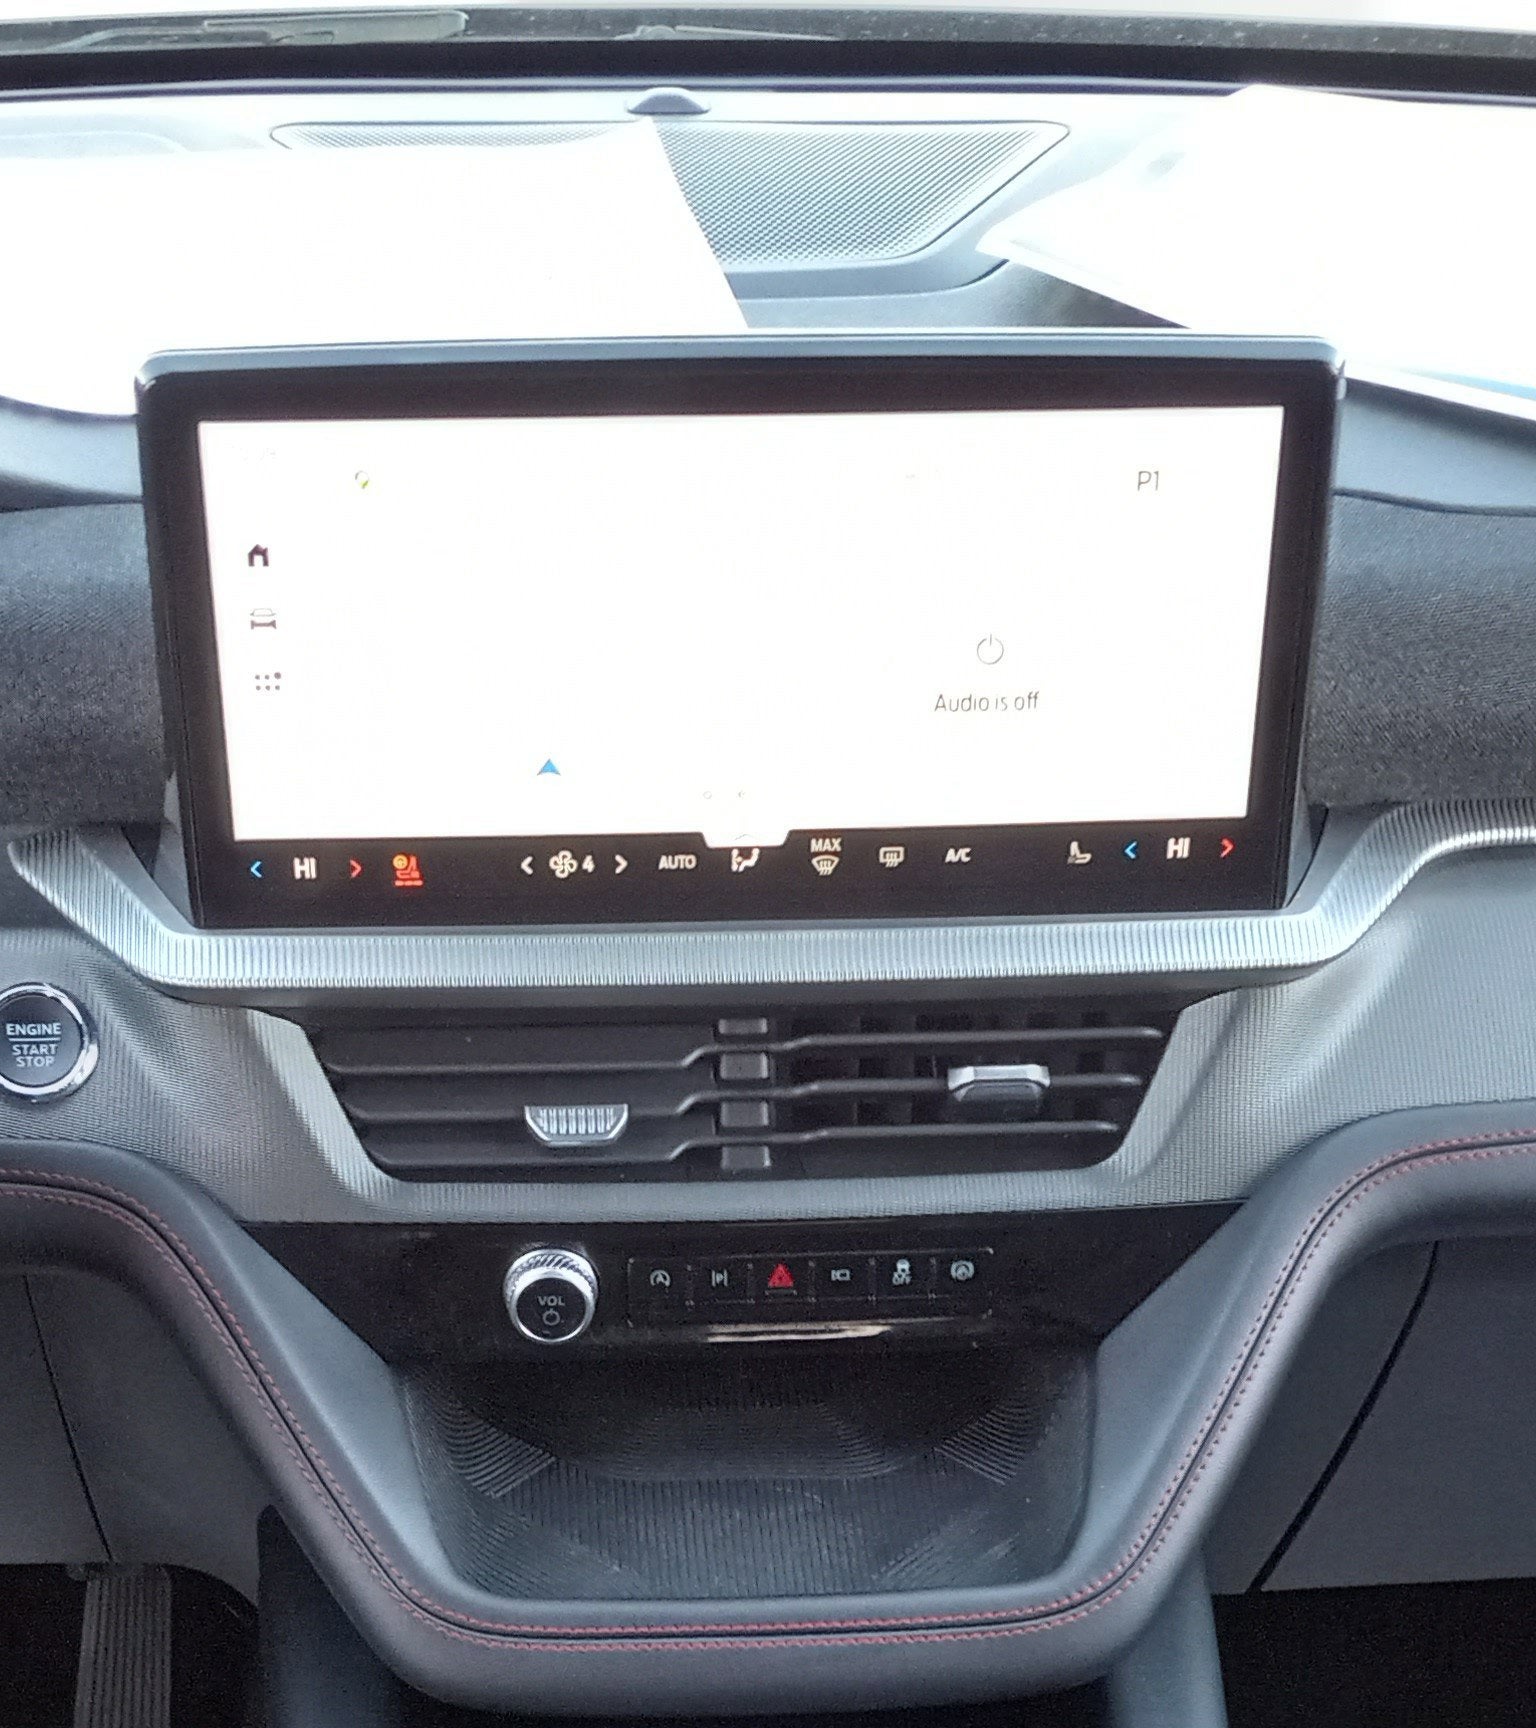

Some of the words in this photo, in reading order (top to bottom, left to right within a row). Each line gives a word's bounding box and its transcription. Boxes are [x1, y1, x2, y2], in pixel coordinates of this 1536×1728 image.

[934, 694, 989, 712] Audio
[995, 696, 1008, 711] is
[1014, 691, 1040, 711] off
[810, 837, 842, 852] MAX
[1166, 837, 1191, 859] HI
[658, 854, 697, 870] AUTO
[944, 847, 971, 863] A/C
[293, 857, 317, 879] HI
[582, 855, 595, 872] 4
[5, 1022, 62, 1036] ENGINE
[12, 1043, 59, 1056] START
[16, 1056, 55, 1068] STOP
[537, 1295, 565, 1306] VOL
